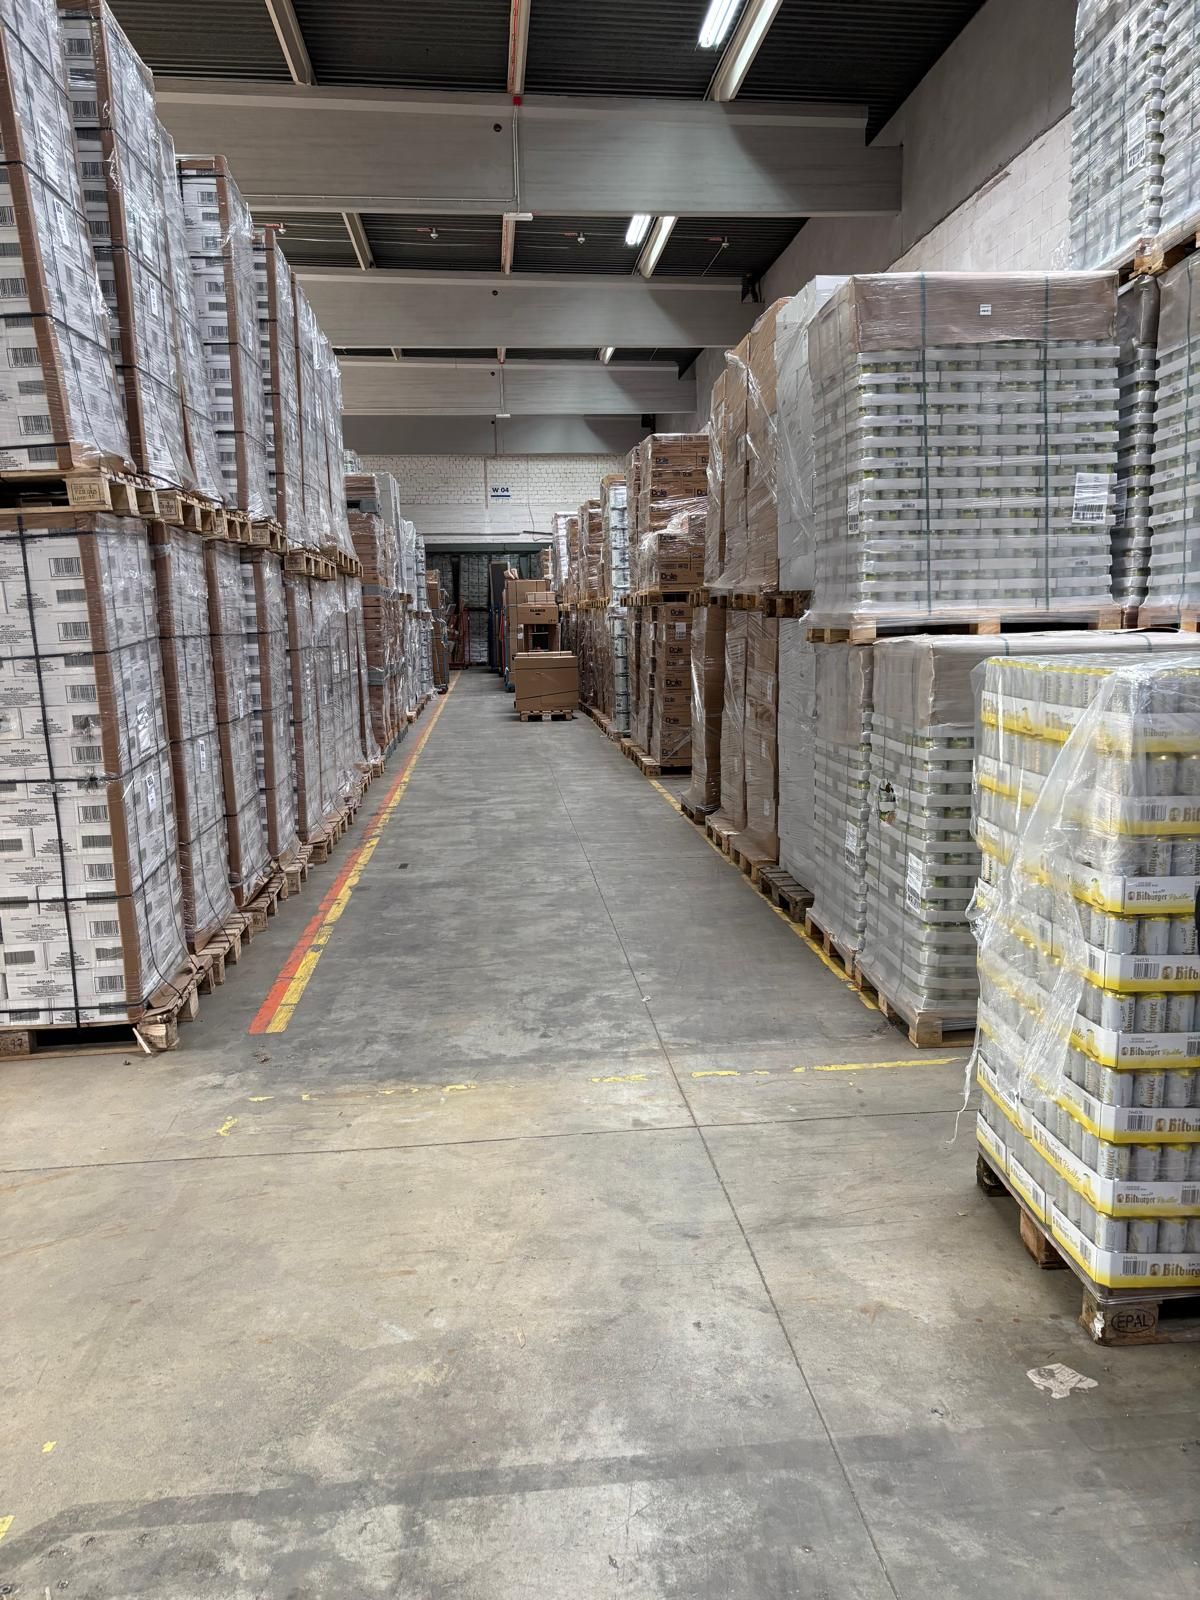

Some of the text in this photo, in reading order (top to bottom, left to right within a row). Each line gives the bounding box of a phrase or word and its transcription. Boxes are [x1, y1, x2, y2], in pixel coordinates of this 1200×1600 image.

[1136, 891, 1167, 901] Bitburger
[1129, 1047, 1160, 1056] Bitburger
[1125, 1193, 1155, 1204] Bitburger
[1116, 1314, 1149, 1329] EPAL
